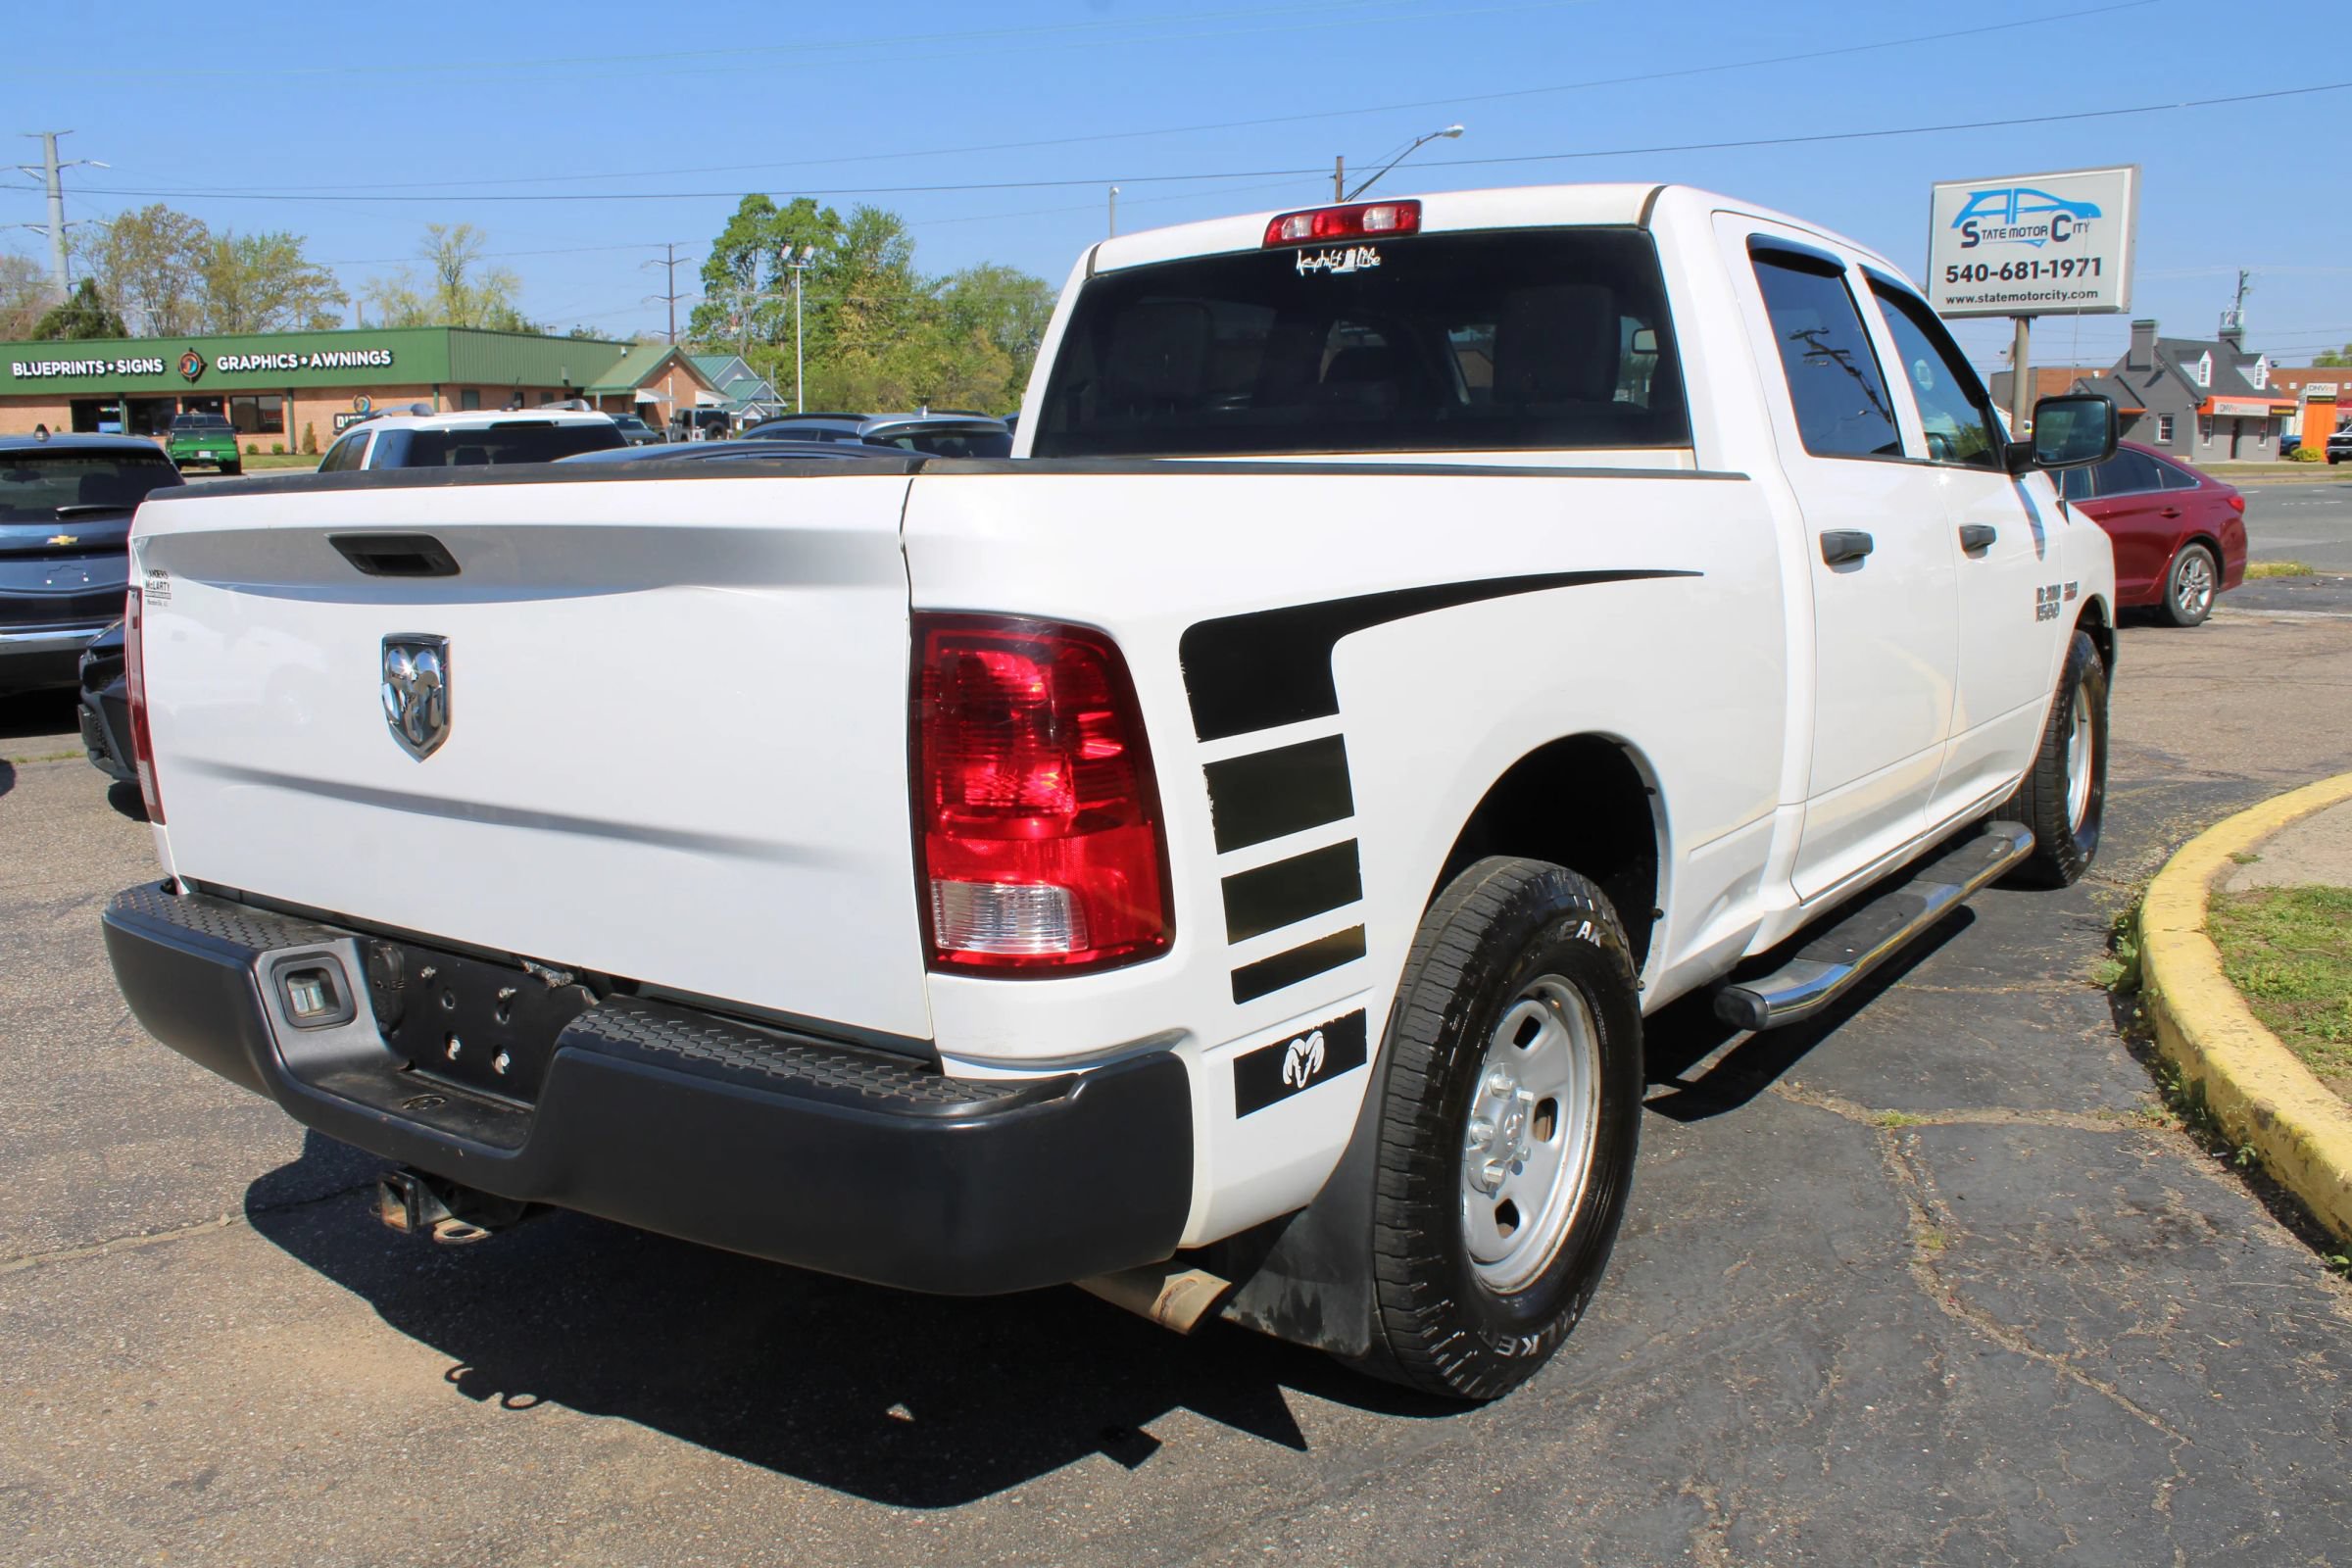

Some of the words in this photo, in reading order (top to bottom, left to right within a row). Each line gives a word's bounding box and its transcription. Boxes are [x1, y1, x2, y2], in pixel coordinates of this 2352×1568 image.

[1961, 220, 2006, 248] STATE
[2009, 225, 2048, 238] MOTOR
[2051, 214, 2090, 242] CITY
[1945, 257, 2102, 284] 540-681-1971
[1945, 289, 2099, 306] www.statemotorcity.com
[12, 360, 106, 376] BLUEPRINTS
[116, 358, 164, 373] SIGNS
[217, 354, 298, 370] GRAPHICS
[311, 350, 392, 368] AWNINGS
